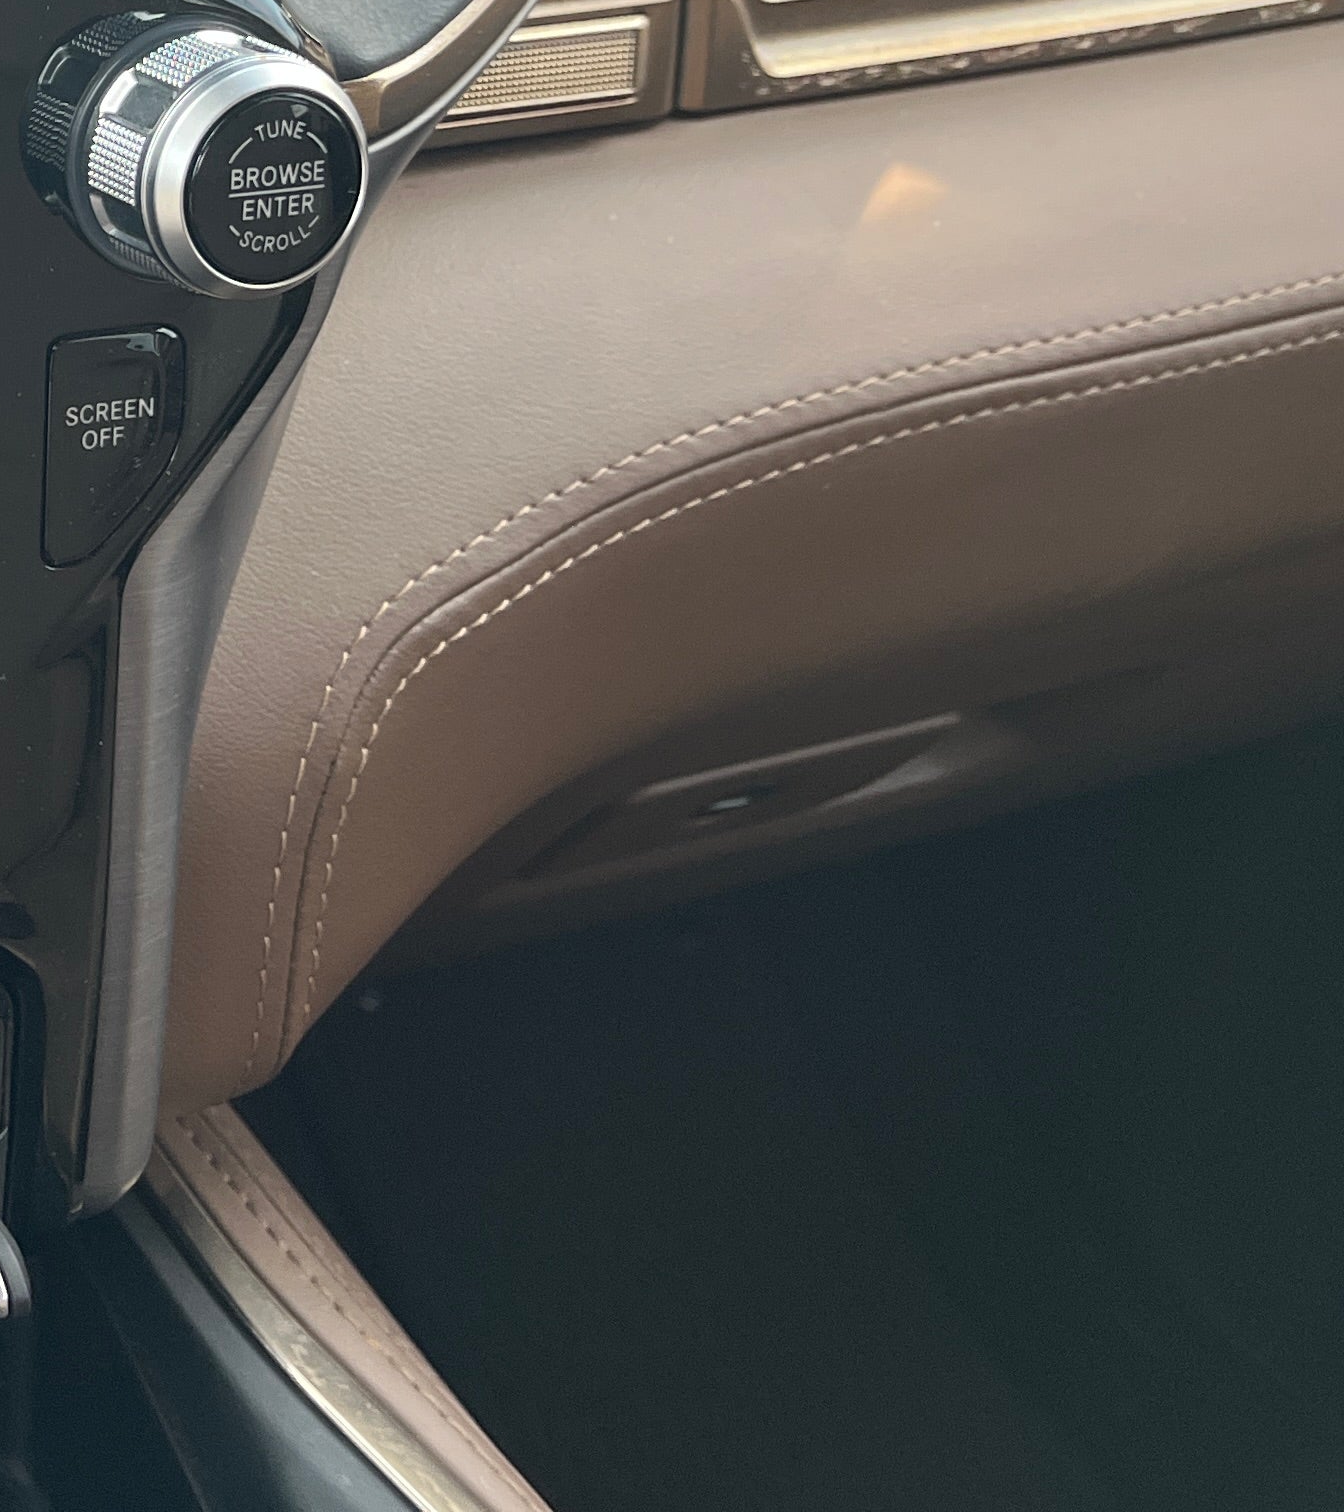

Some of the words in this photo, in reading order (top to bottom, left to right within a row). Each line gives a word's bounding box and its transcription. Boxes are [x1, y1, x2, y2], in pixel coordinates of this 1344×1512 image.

[254, 119, 307, 144] TUNE
[228, 159, 326, 192] BROWSE
[240, 192, 315, 222] ENTER
[238, 225, 312, 254] SCROLL
[65, 396, 155, 428] SCREEN
[81, 426, 126, 451] OFF
